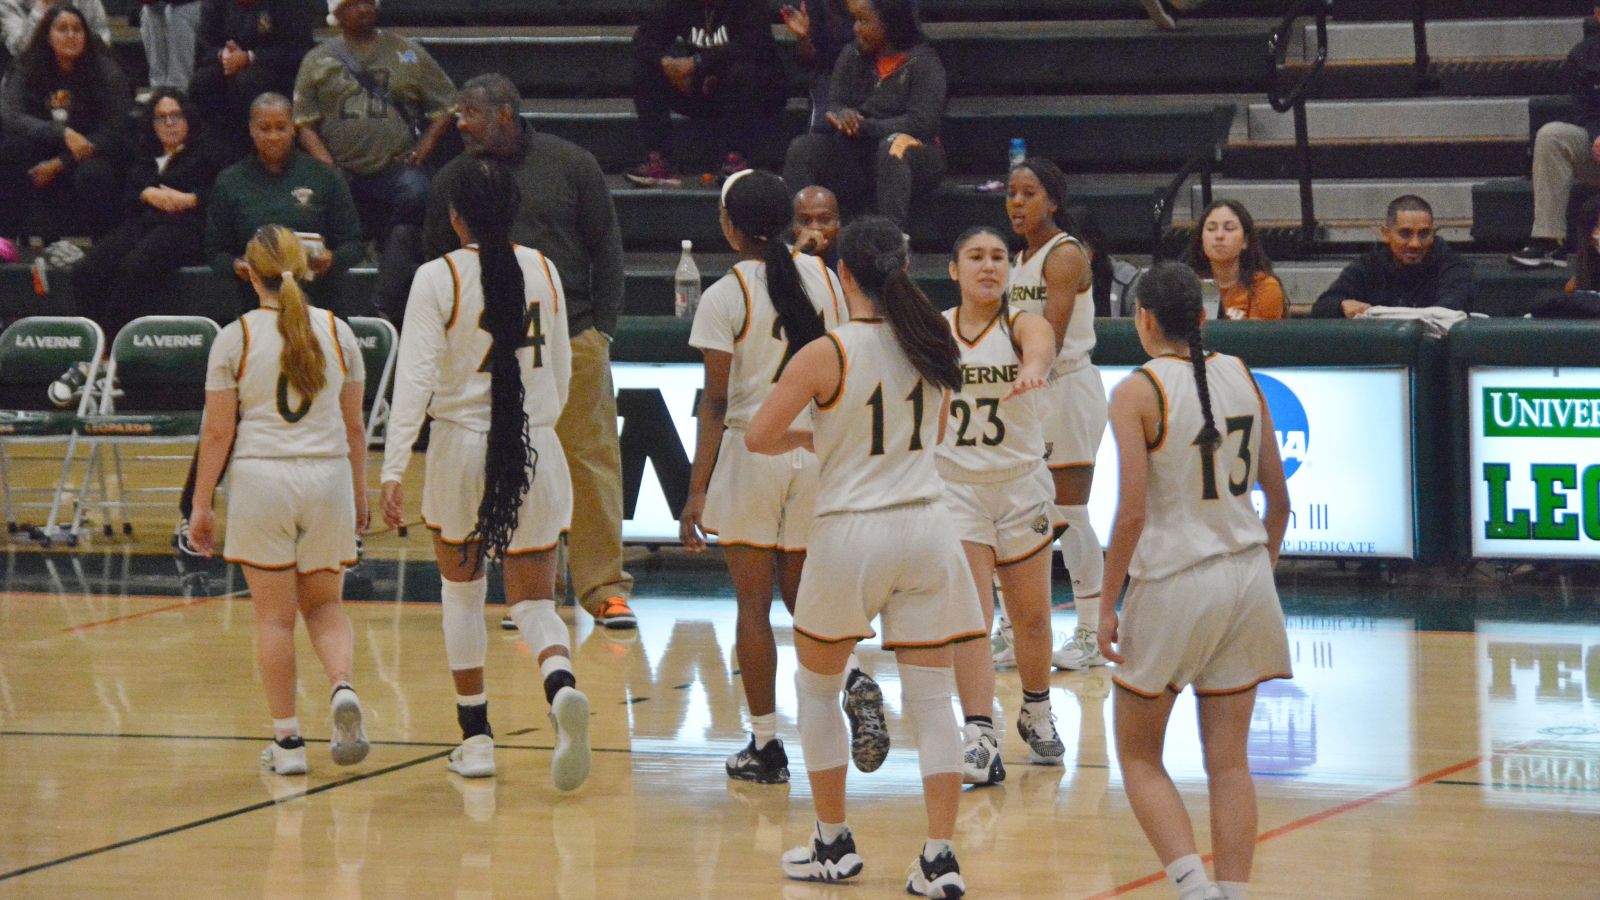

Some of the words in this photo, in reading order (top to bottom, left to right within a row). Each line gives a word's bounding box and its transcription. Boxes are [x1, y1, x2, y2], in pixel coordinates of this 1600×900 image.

[1009, 285, 1047, 301] ERNE
[16, 334, 34, 347] LA
[35, 336, 82, 348] VERNE
[133, 334, 153, 346] LA
[153, 335, 203, 347] VERNE
[865, 376, 924, 456] 11
[950, 398, 1005, 446] 23
[1190, 414, 1254, 500] 13
[1299, 541, 1375, 553] DEDICATE
